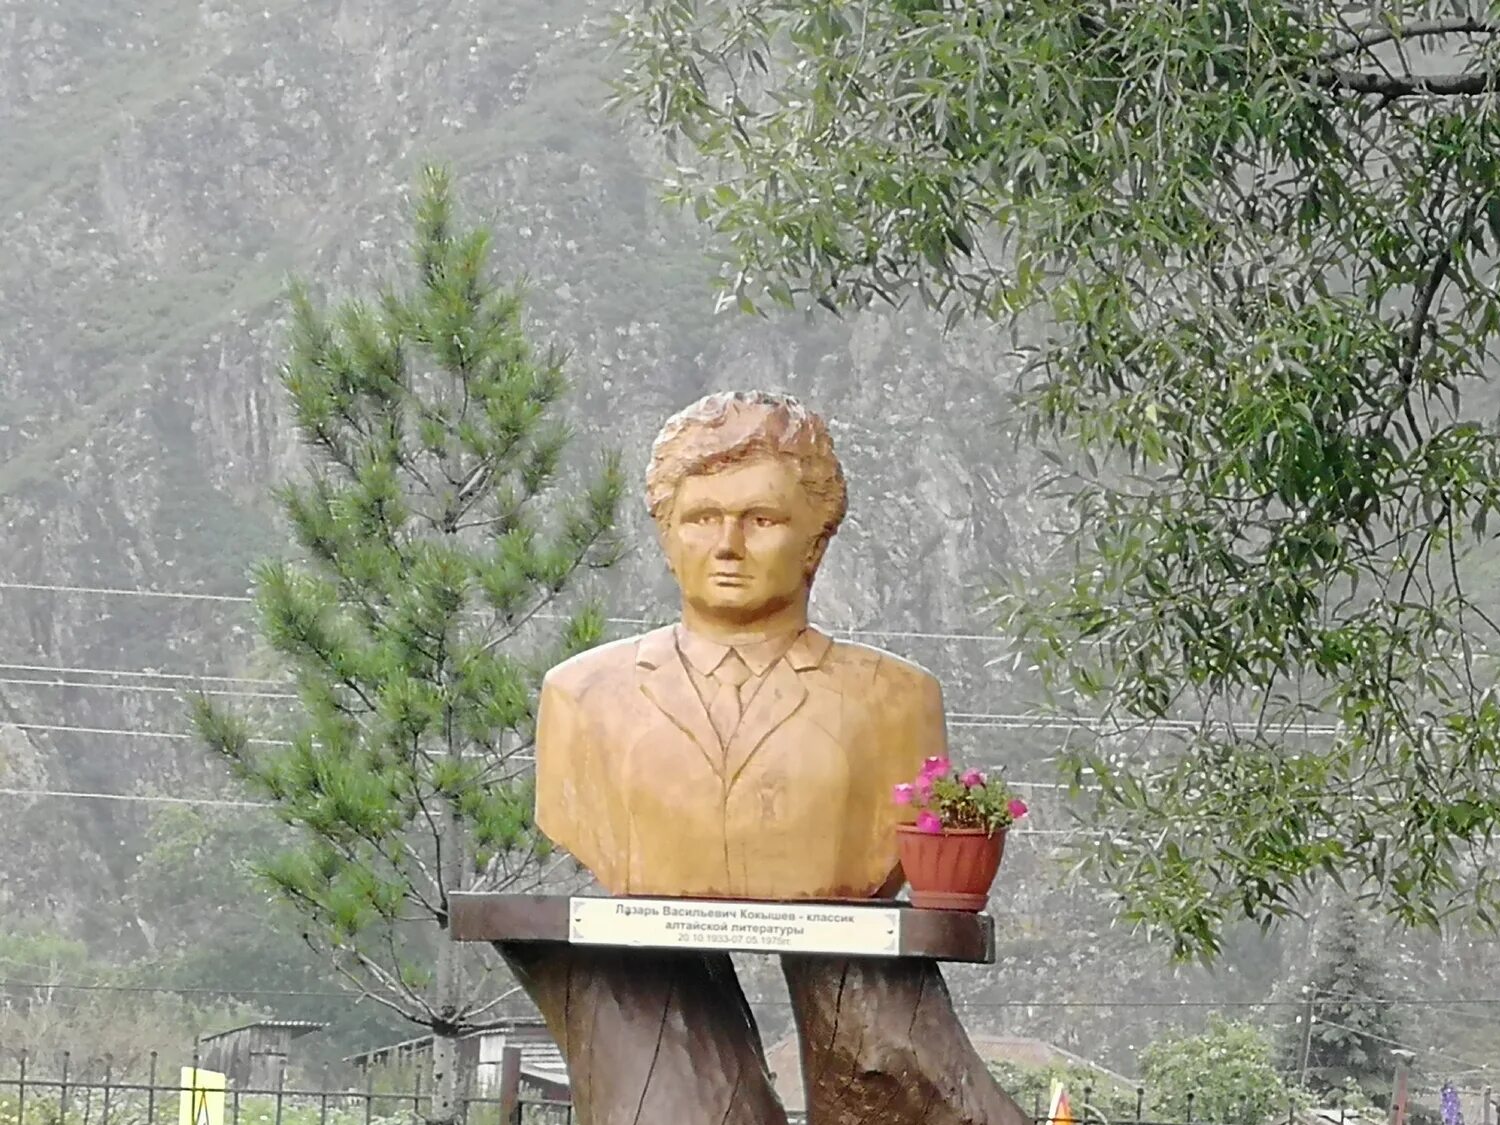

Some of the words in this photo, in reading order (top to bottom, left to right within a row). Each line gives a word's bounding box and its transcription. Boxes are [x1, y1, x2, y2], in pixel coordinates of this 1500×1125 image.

[662, 906, 737, 919] Васильевич
[740, 909, 796, 921] Кокышев
[806, 914, 855, 924] классик
[665, 920, 728, 932] алтайской
[731, 924, 805, 936] литературы
